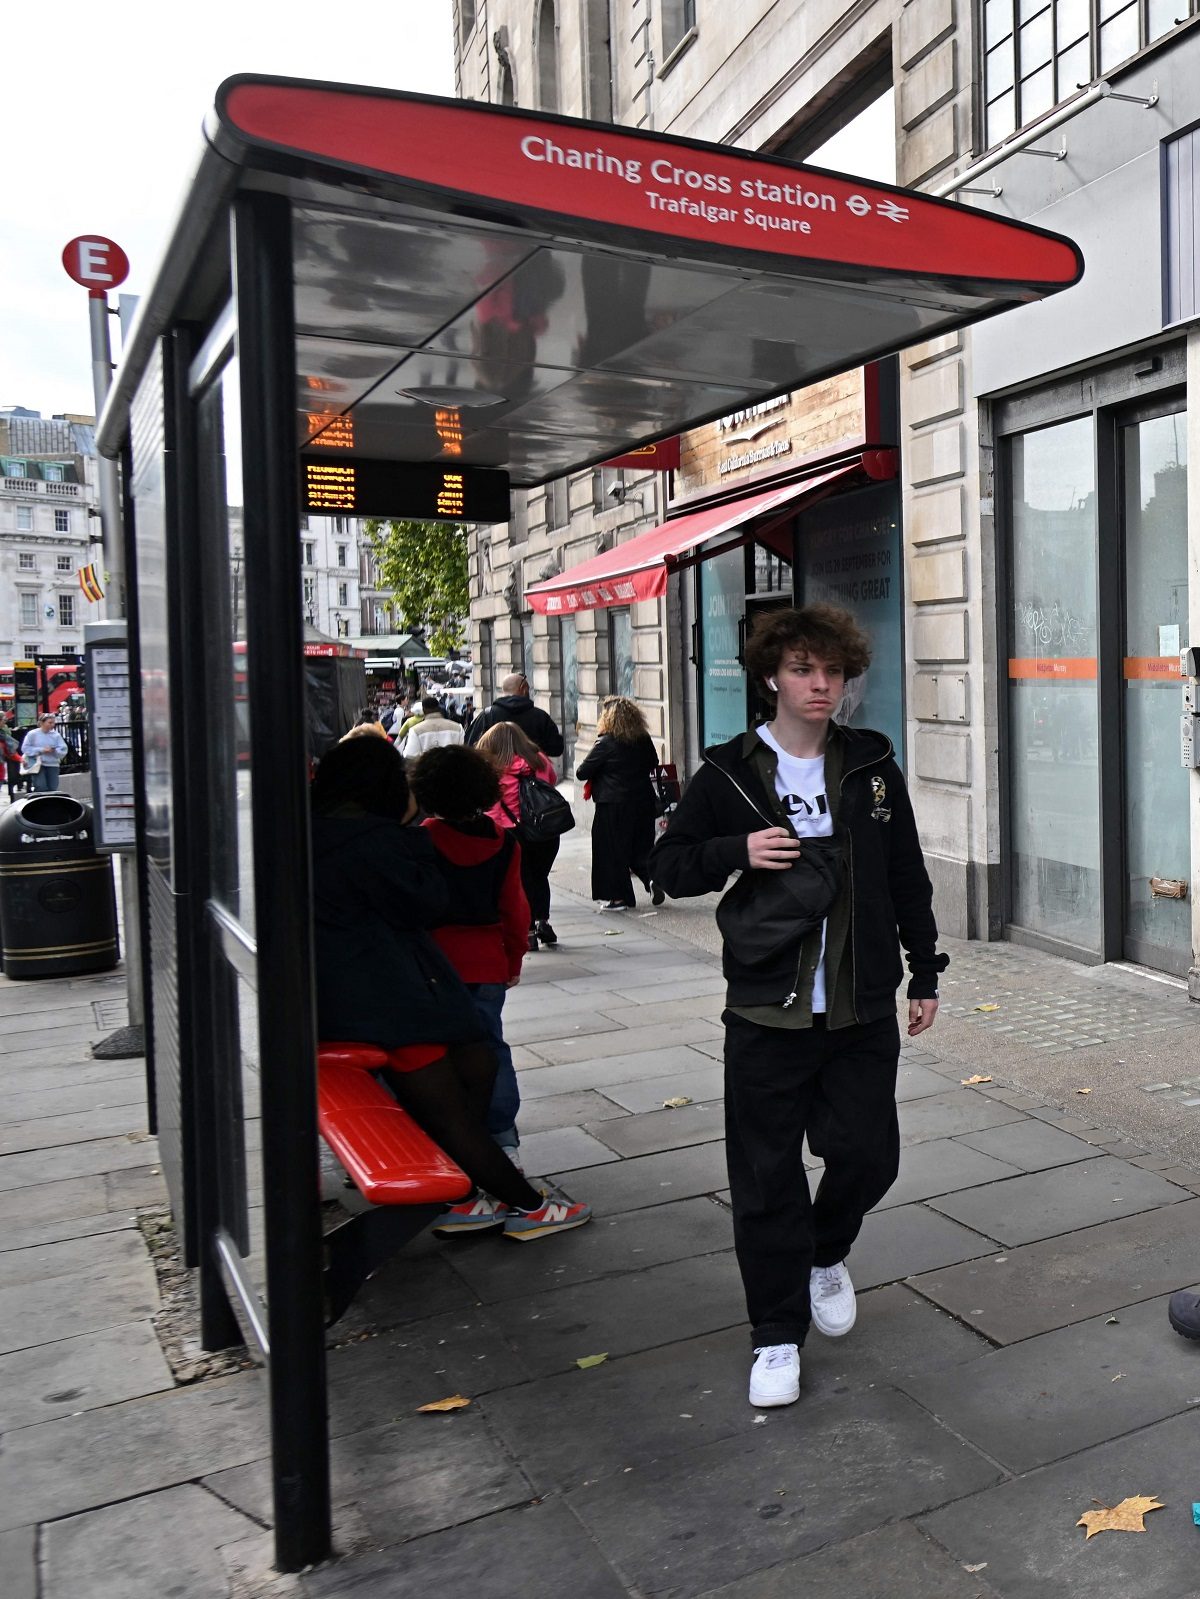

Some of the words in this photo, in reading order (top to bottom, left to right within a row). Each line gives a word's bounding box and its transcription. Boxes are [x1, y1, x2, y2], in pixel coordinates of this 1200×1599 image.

[521, 134, 642, 183] Charing
[651, 159, 733, 195] Cross
[740, 179, 837, 213] station
[645, 191, 739, 224] Trafalgar
[743, 207, 812, 236] Square
[78, 240, 113, 282] E
[877, 550, 891, 566] FOR
[860, 577, 891, 601] GREAT
[708, 594, 725, 617] JOIN
[541, 1204, 568, 1222] N
